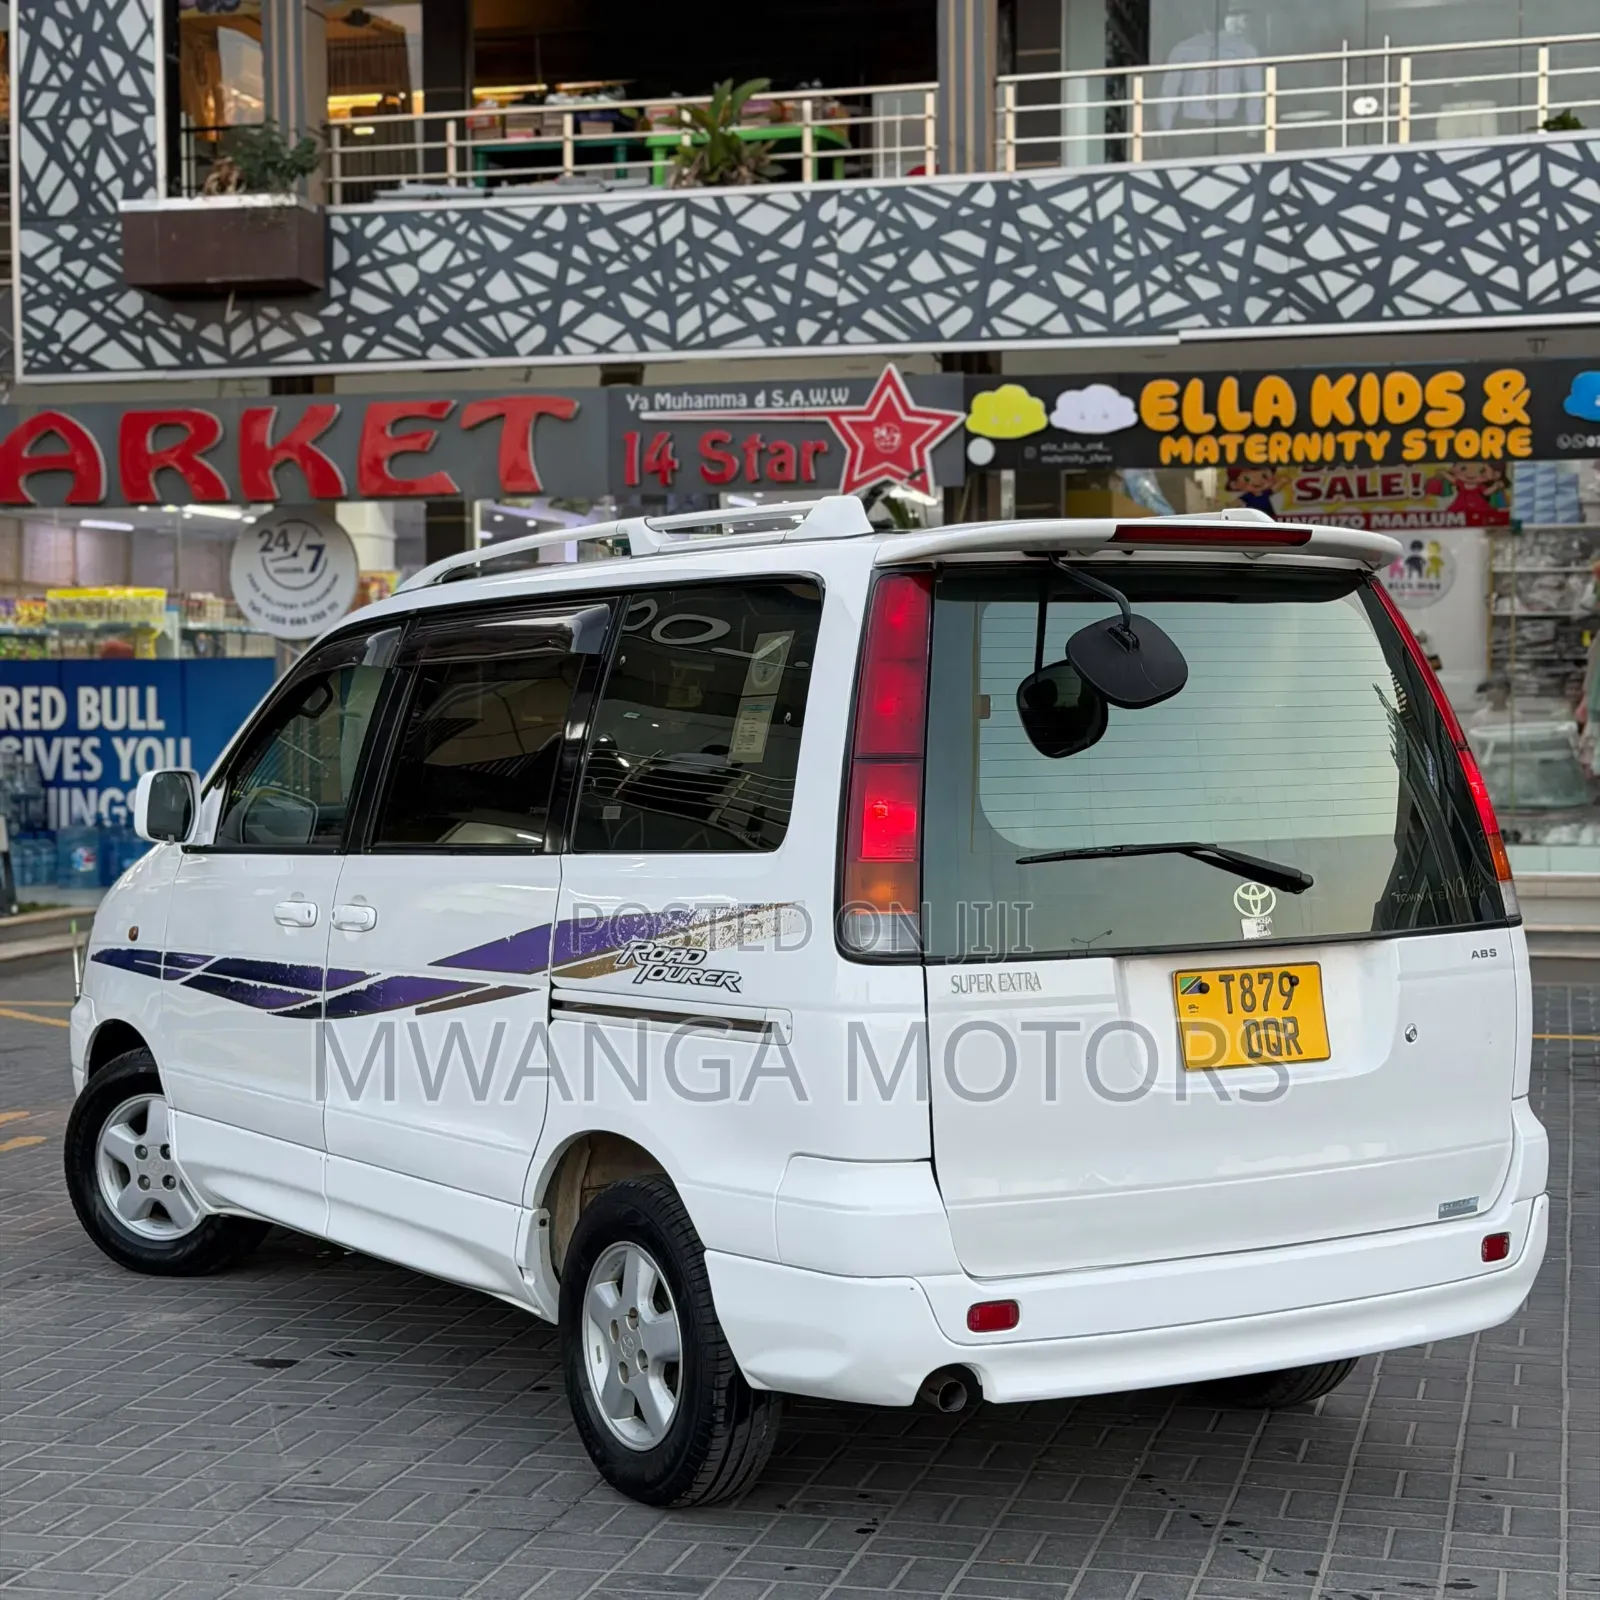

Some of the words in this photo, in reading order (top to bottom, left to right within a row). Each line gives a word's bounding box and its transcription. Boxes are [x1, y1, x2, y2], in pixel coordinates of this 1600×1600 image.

[626, 393, 649, 411] Ya
[654, 391, 747, 410] Muhamma
[755, 391, 766, 407] d
[772, 387, 849, 408] S.A.W.W
[1140, 375, 1297, 434] ELLA
[1310, 370, 1465, 428] KIDS
[1482, 369, 1532, 426] &
[0, 396, 579, 504] ARKET
[624, 430, 679, 488] 14
[698, 429, 828, 485] Star
[1160, 430, 1391, 465] MATERNITY
[1402, 427, 1533, 461] STORE
[1295, 472, 1424, 502] SALE!
[1371, 511, 1466, 529] MAALUM
[258, 528, 290, 552] 24
[305, 543, 325, 573] 7
[0, 685, 67, 731] RED
[77, 685, 166, 731] BULL
[111, 736, 192, 782] YOU
[616, 940, 708, 965] ROAD
[1471, 948, 1497, 960] ABS
[632, 960, 742, 993] TOURER
[951, 973, 996, 994] SUPER
[998, 971, 1042, 992] EXTRA
[1218, 971, 1298, 1015] T879
